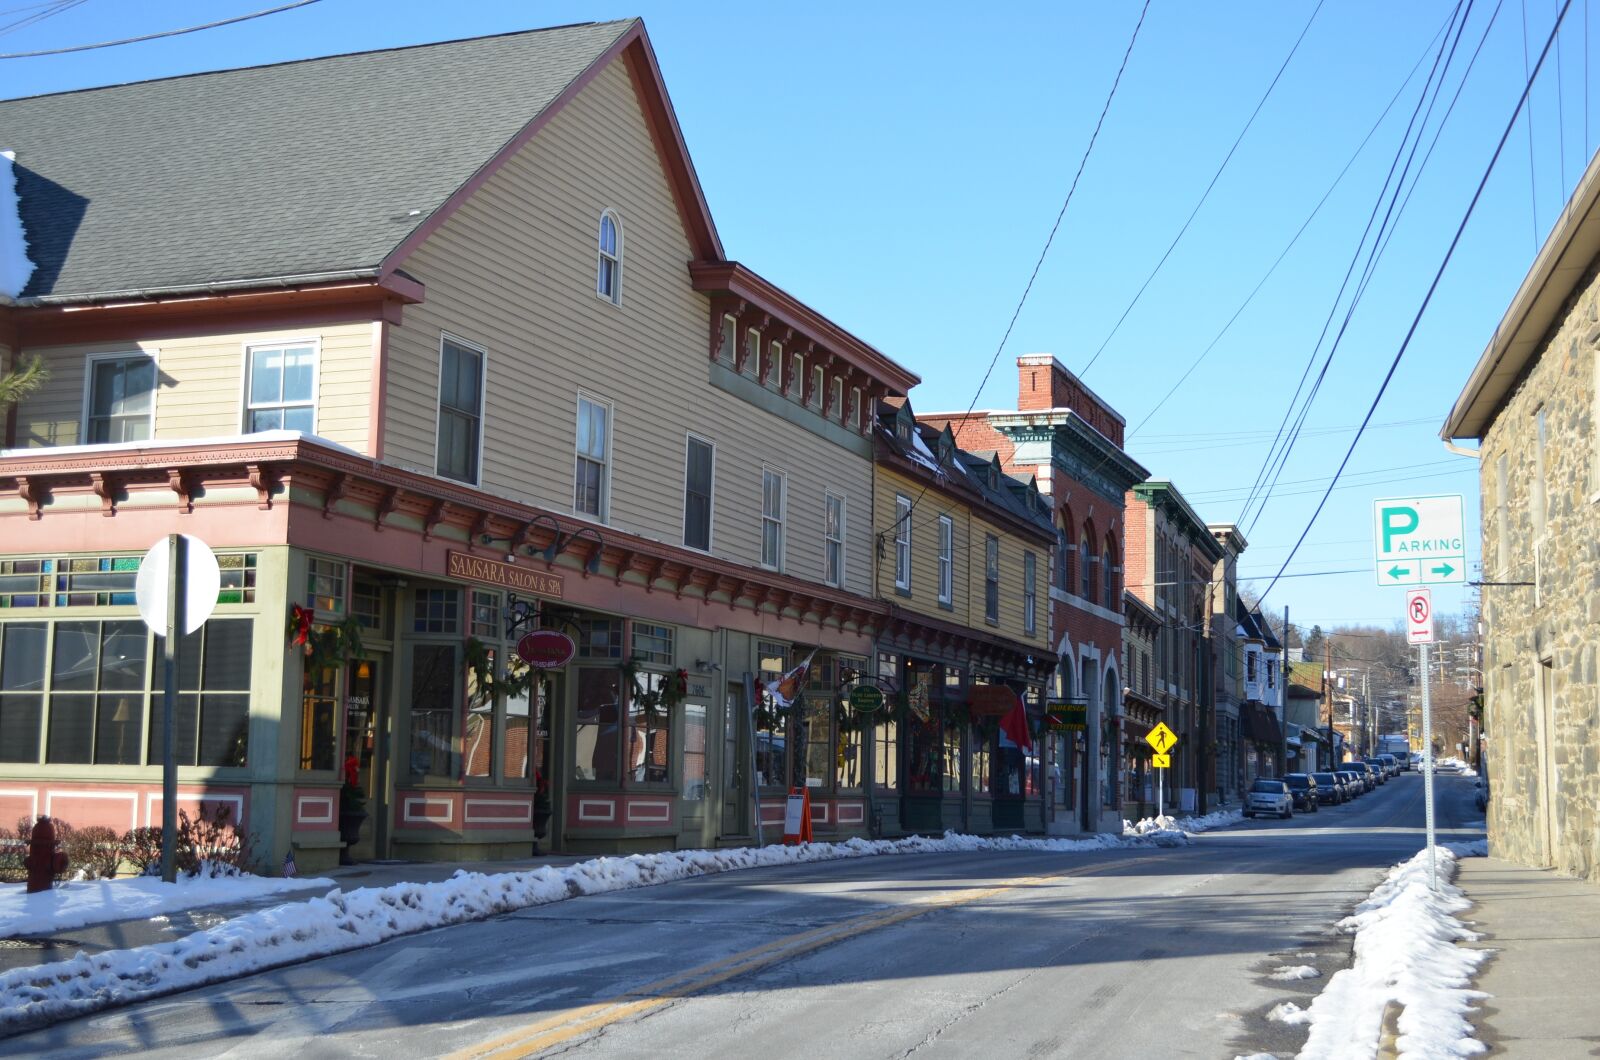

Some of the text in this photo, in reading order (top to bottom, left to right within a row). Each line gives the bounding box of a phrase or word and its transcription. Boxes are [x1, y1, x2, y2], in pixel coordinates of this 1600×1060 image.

[1382, 507, 1461, 553] PARKING
[451, 555, 561, 594] SAMSARA SALON & SPA
